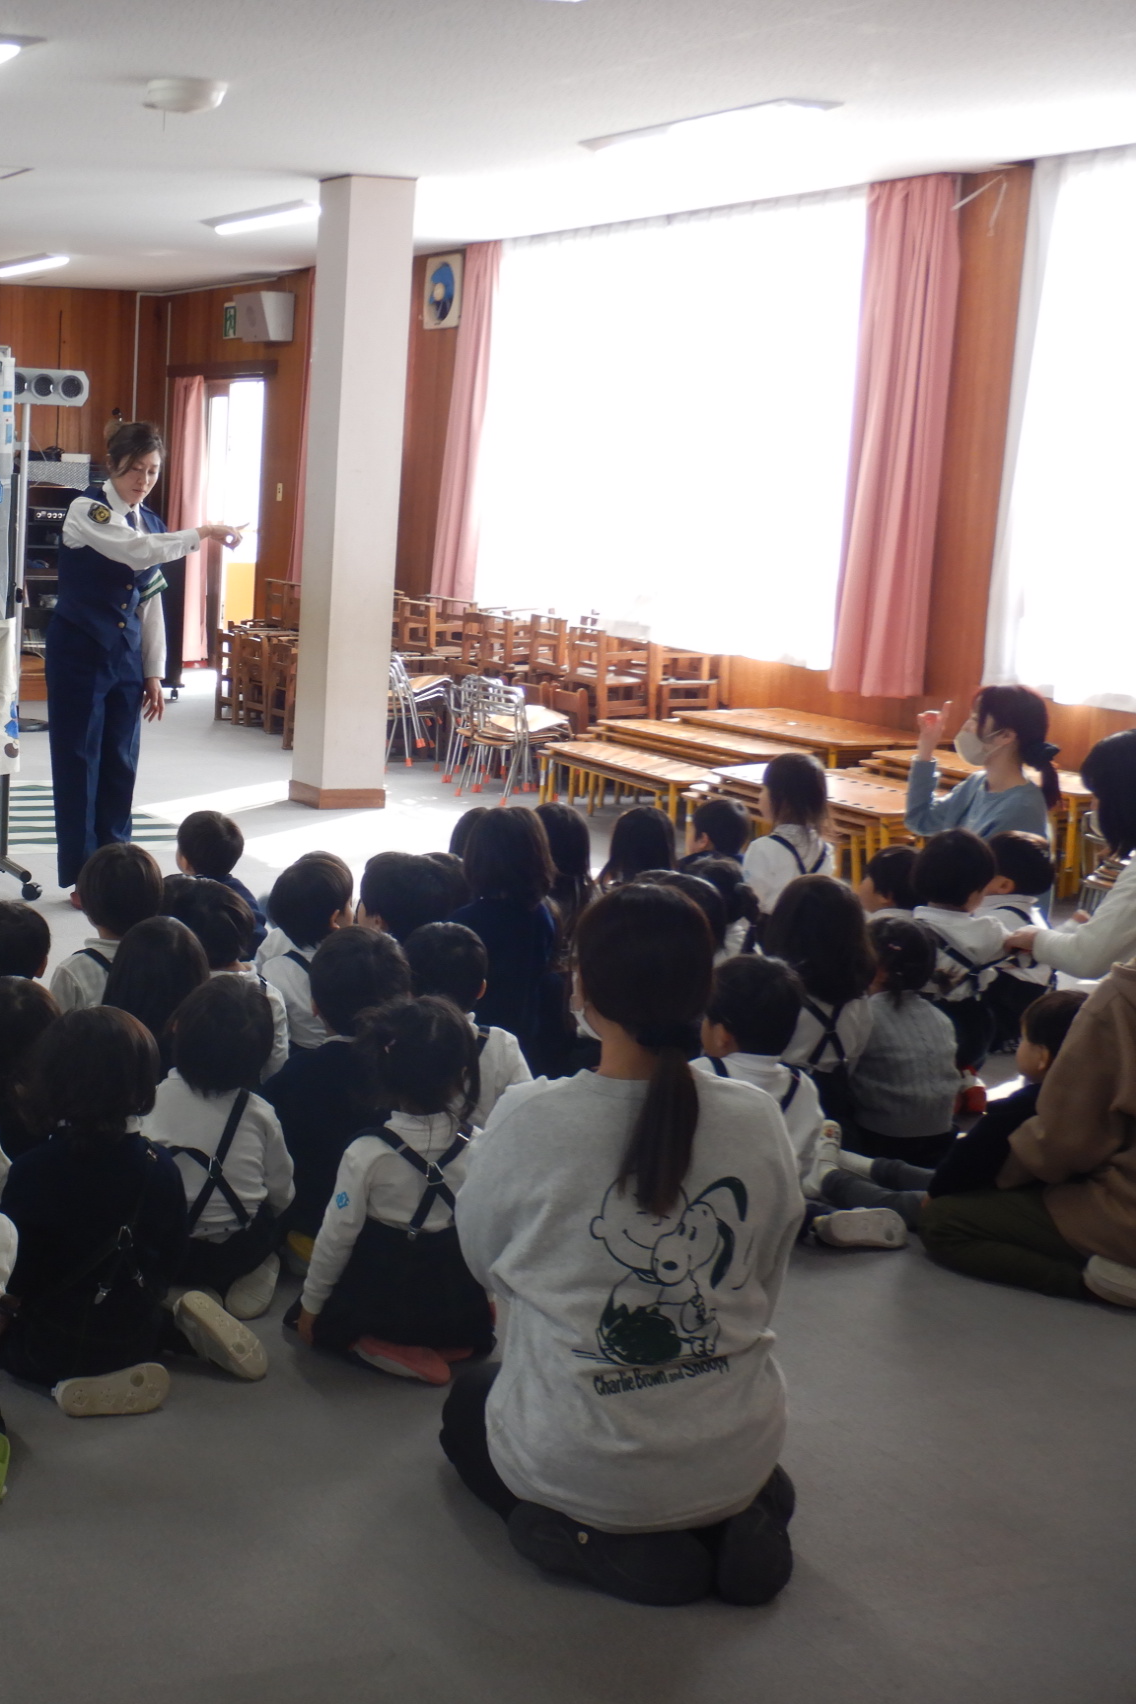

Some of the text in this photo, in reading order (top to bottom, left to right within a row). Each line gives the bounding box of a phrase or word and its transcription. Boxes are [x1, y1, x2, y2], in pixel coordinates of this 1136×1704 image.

[593, 1356, 730, 1396] Charlie Brown and Snoopy
